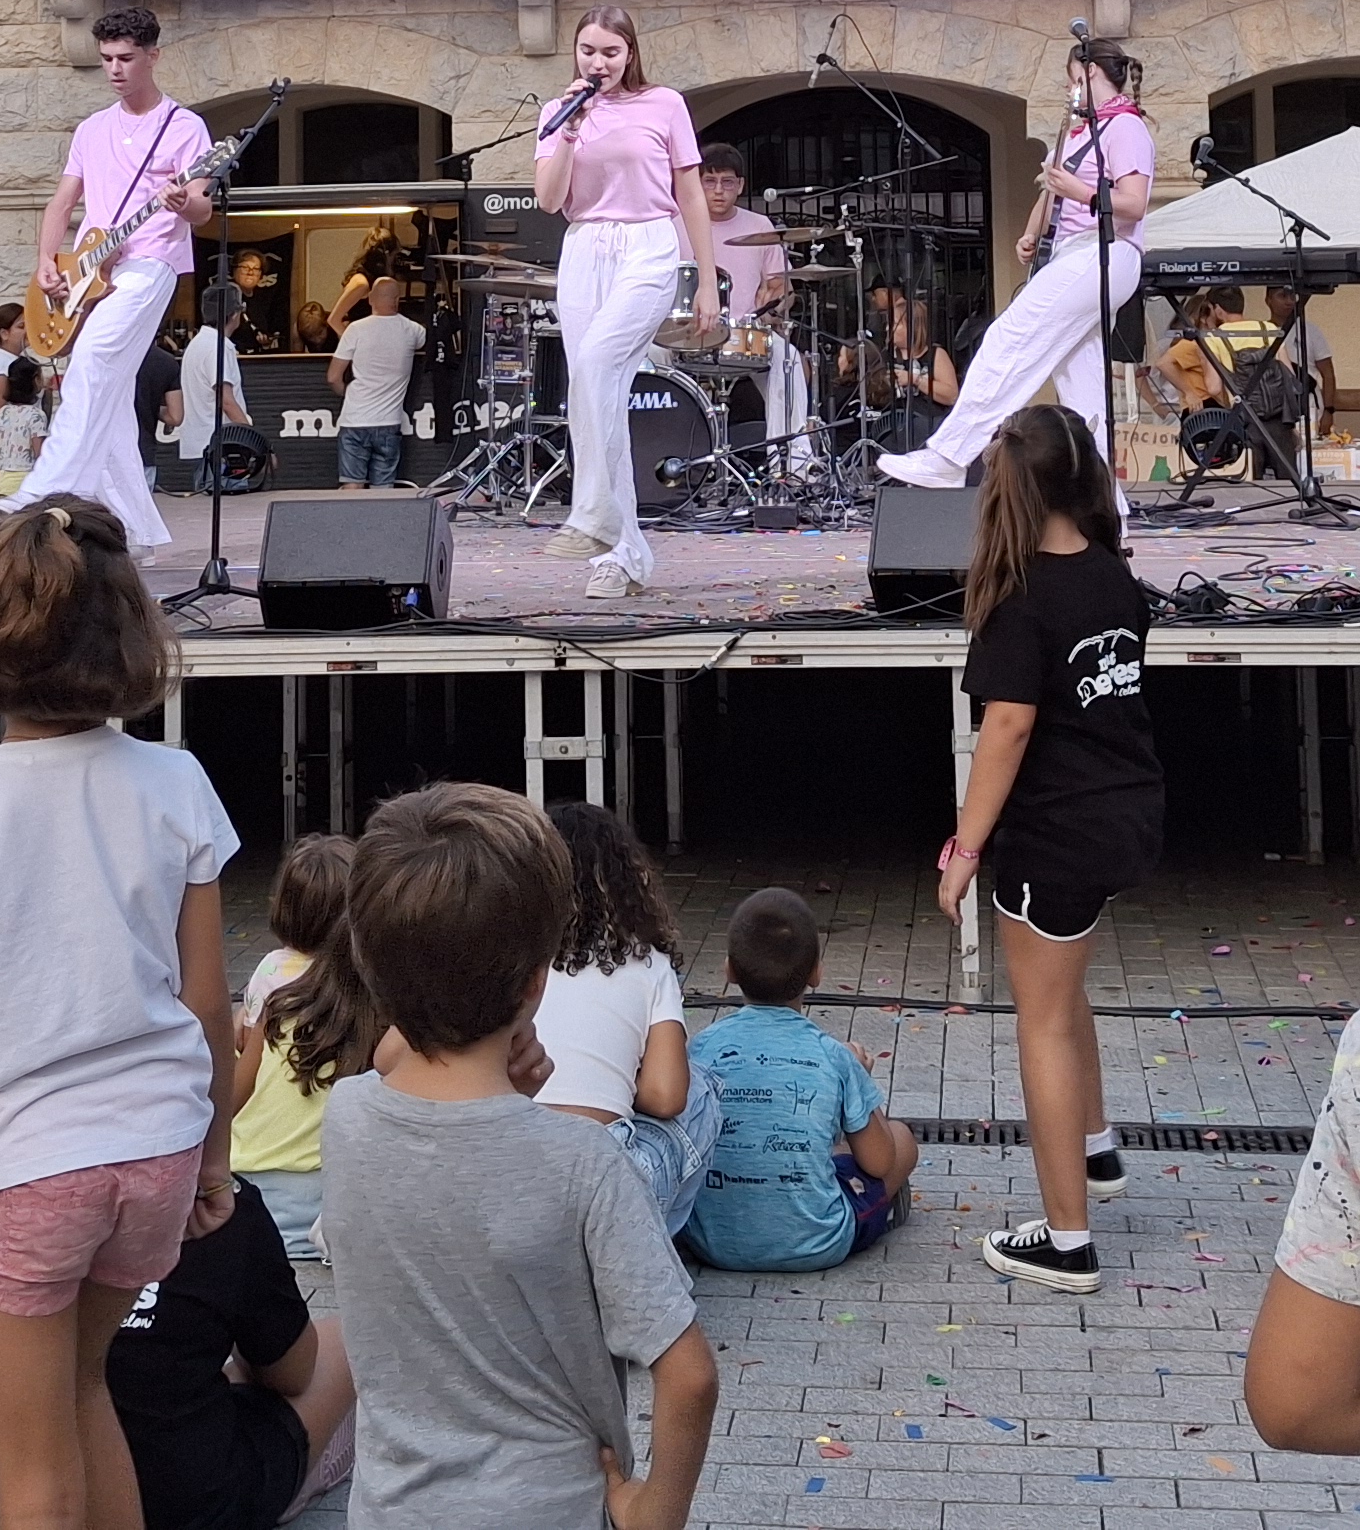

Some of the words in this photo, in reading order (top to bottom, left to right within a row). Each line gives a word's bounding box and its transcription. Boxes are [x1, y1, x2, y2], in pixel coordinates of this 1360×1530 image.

[1159, 262, 1198, 273] Roland
[1201, 261, 1240, 272] E-70
[628, 391, 673, 411] AMA
[722, 1087, 774, 1098] manzano
